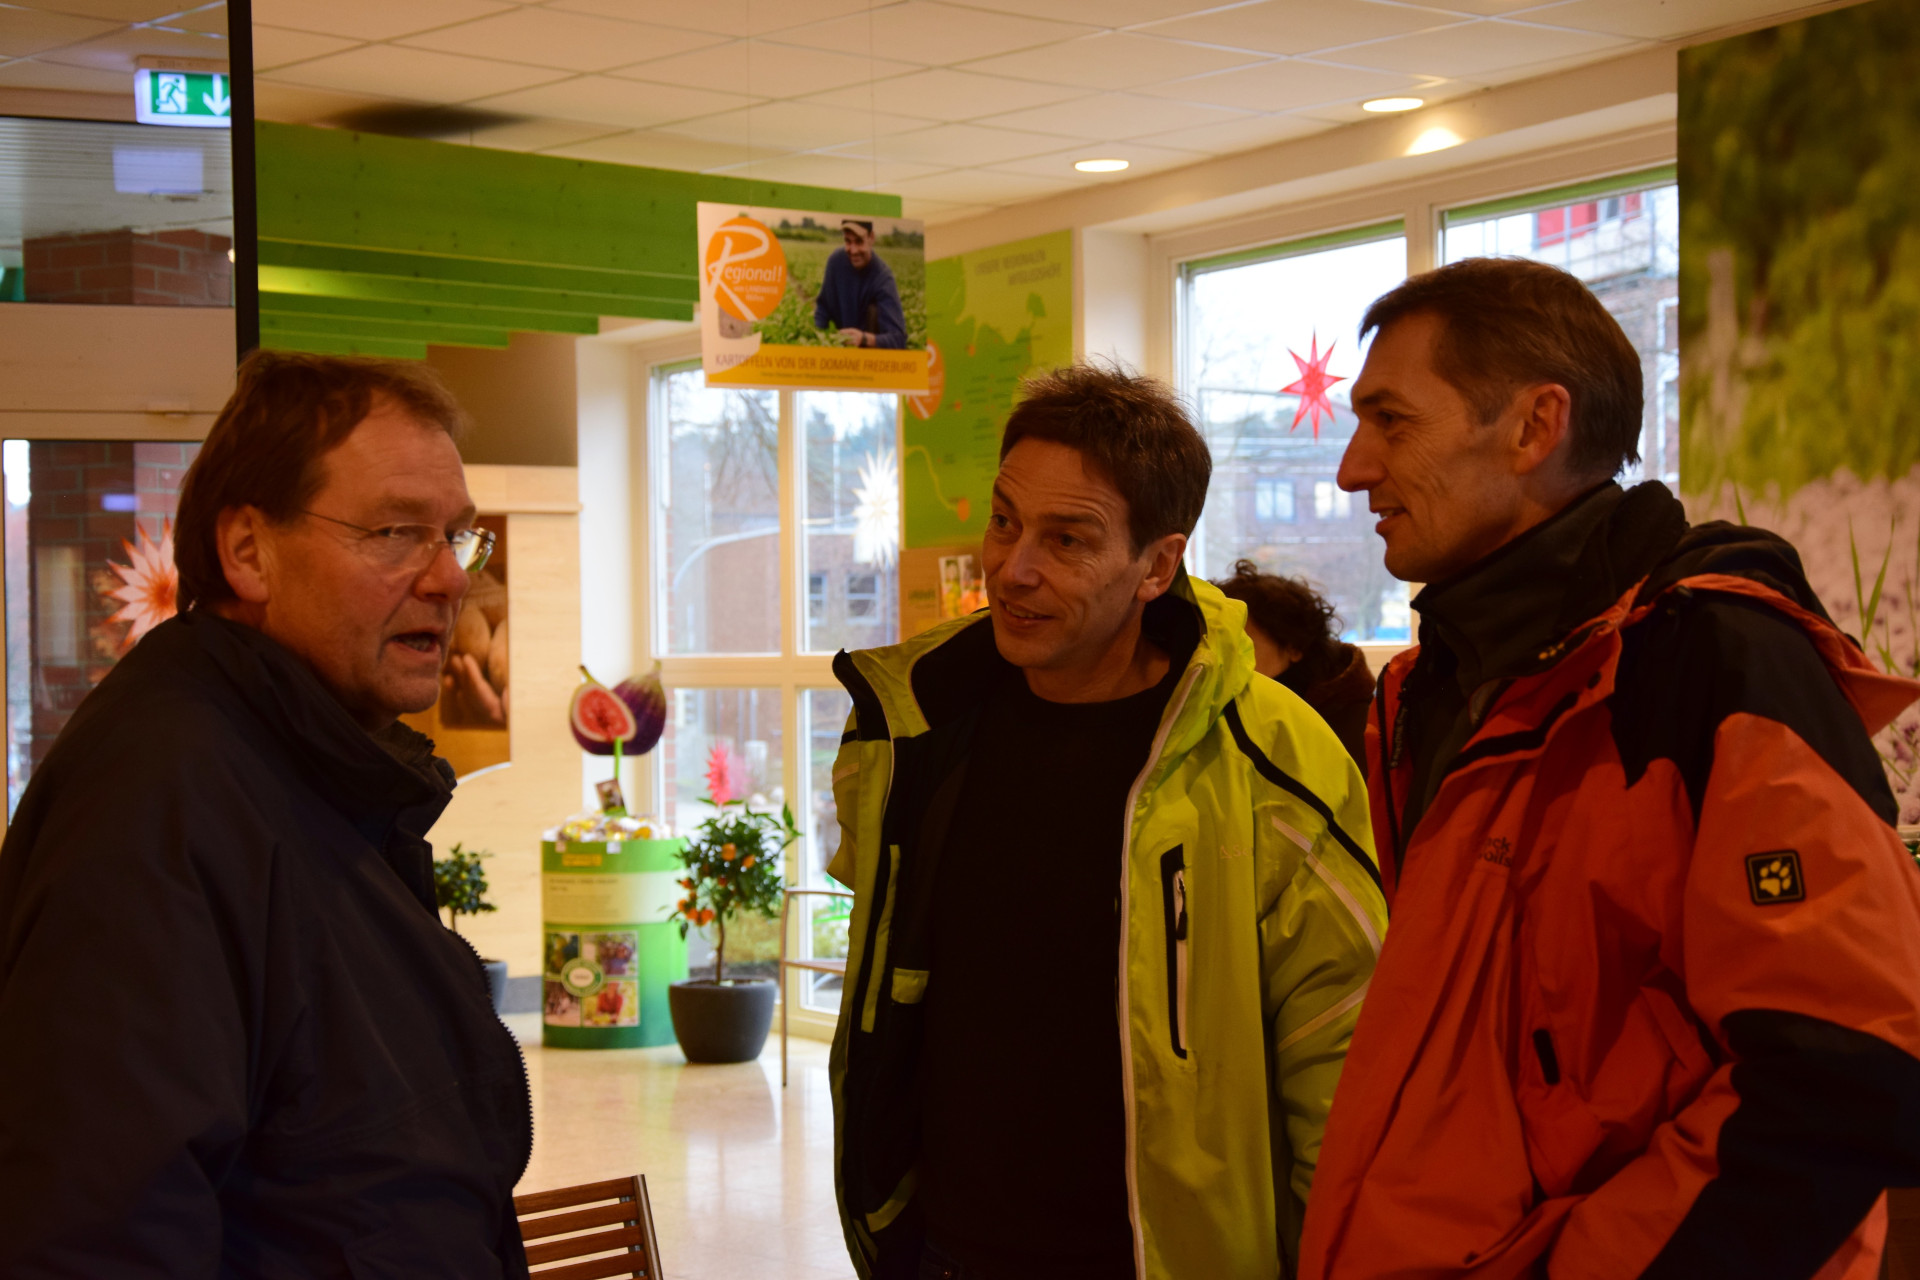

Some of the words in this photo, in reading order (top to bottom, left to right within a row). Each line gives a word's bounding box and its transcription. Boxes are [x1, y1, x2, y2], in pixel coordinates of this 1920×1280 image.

[707, 225, 783, 322] Regional!
[715, 353, 773, 369] KARTOFFELN
[775, 356, 796, 370] VON
[798, 356, 816, 371] DER
[819, 356, 861, 373] DOMÄNE
[863, 358, 917, 375] FREDEBURG
